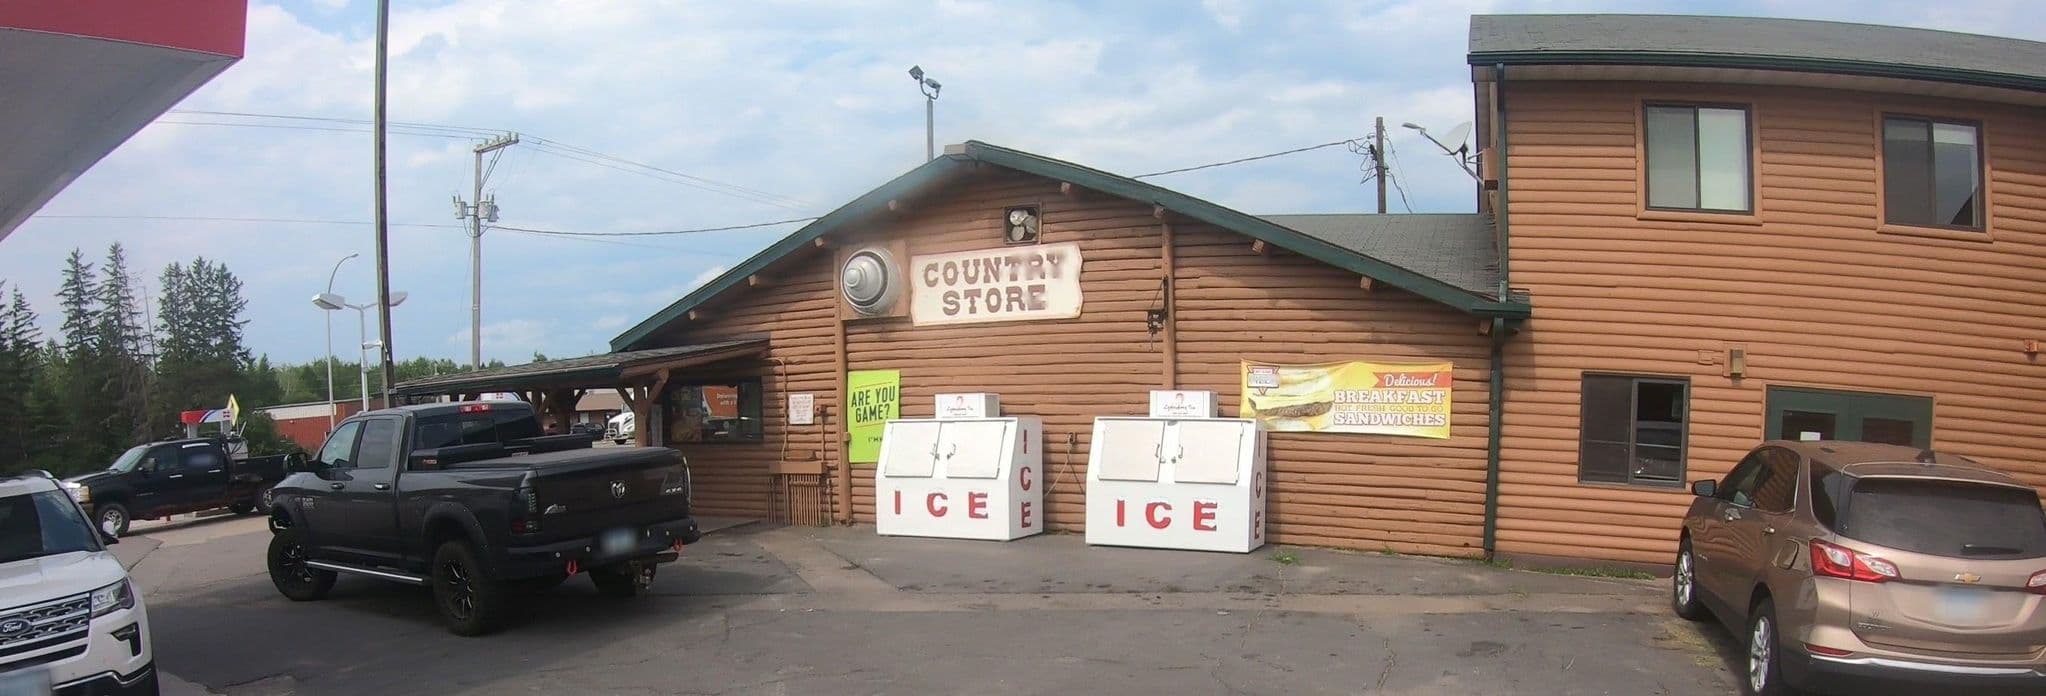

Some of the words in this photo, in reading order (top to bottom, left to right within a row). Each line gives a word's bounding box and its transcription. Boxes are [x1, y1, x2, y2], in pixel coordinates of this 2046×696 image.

[924, 253, 1061, 287] COUNTRY
[942, 284, 1046, 315] STORE
[1384, 373, 1437, 387] Delicious!
[851, 390, 871, 408] ARE
[875, 386, 895, 404] YOU
[1334, 390, 1446, 404] BREAKFAST
[1356, 404, 1386, 412] FRESH
[856, 403, 890, 423] GAME?
[1334, 413, 1446, 426] SANDWICHES
[1020, 429, 1032, 528] ICE
[1254, 430, 1262, 539] ICE
[895, 489, 989, 519] ICE
[1116, 499, 1218, 531] ICE
[2, 622, 23, 633] Ford
